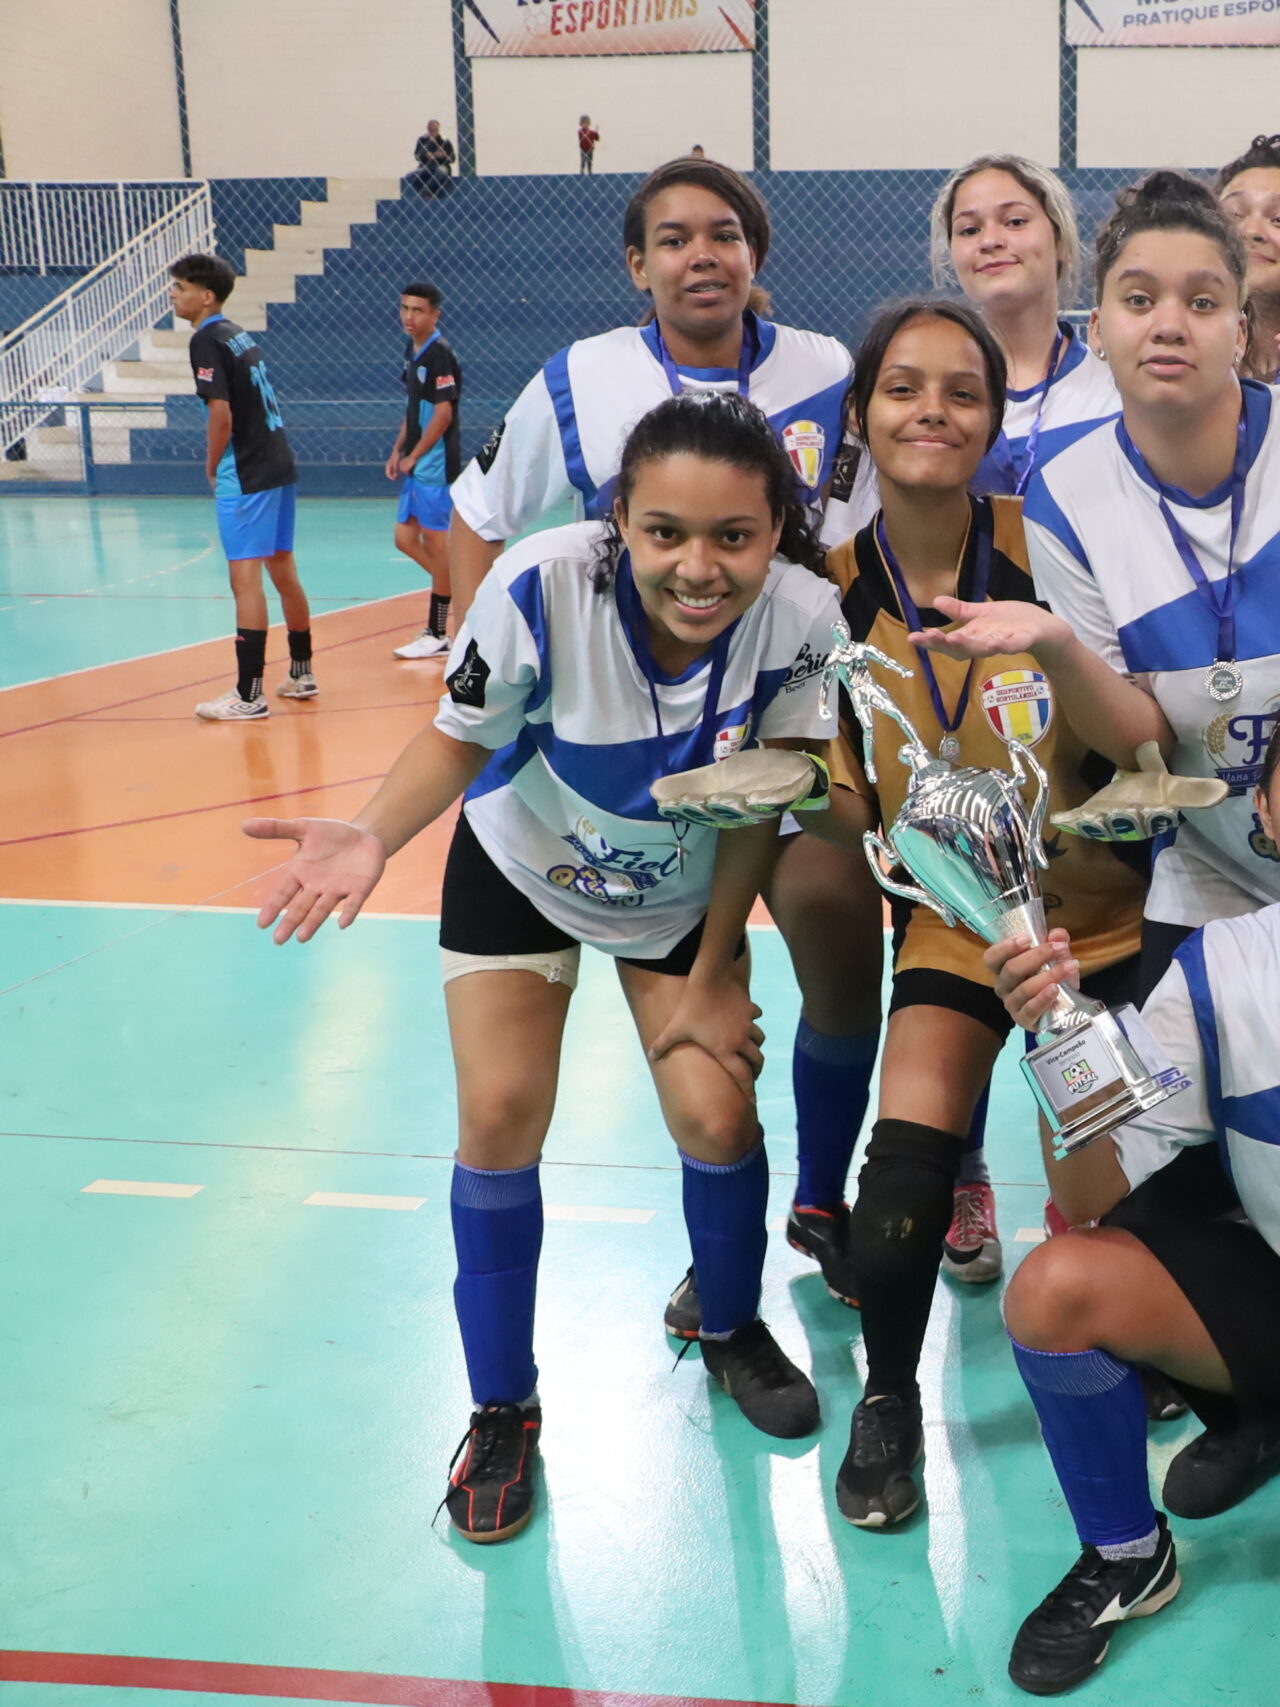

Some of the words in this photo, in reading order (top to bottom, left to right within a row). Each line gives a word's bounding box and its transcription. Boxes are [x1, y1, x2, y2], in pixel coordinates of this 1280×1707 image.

[550, 0, 698, 35] ESPORTIVAS
[1122, 6, 1219, 27] PRATIQUE
[785, 682, 806, 694] Beer
[1046, 1039, 1086, 1065] Vice-Campeão
[1067, 1071, 1099, 1095] FUTSAL
